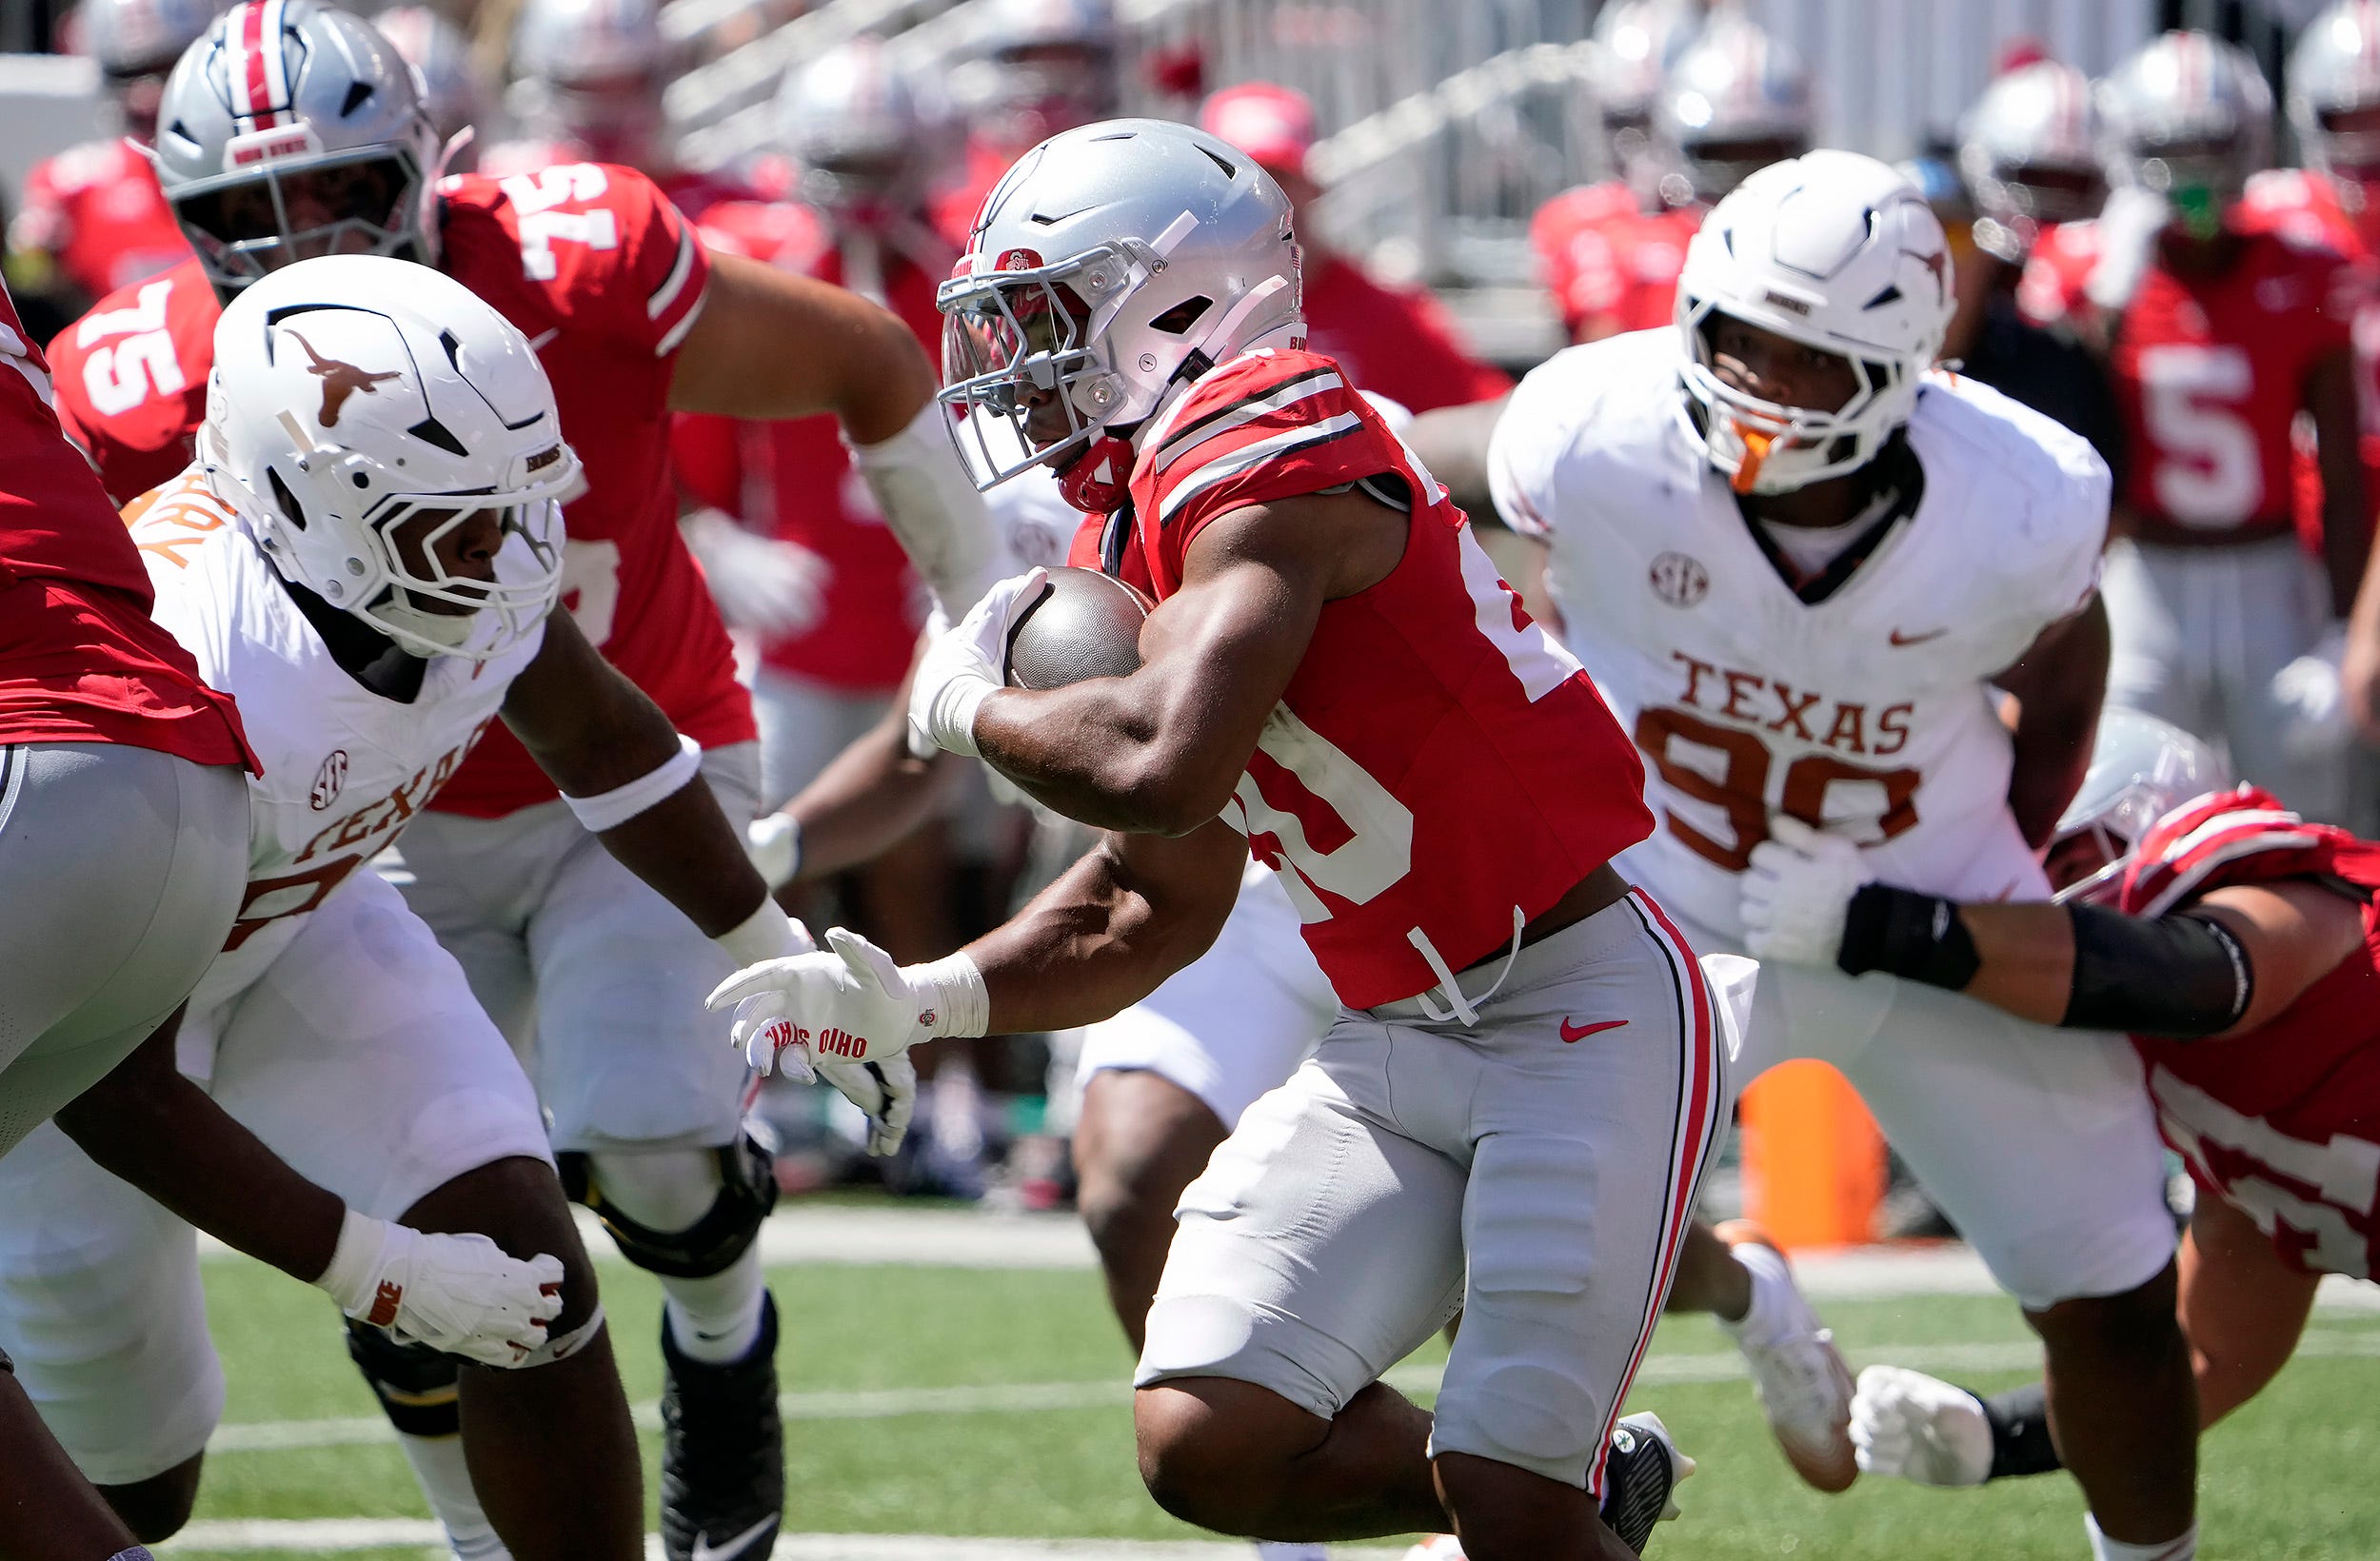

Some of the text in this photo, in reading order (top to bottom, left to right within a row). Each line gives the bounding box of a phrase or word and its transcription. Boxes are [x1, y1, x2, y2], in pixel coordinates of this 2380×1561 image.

[500, 162, 618, 282] 75
[76, 278, 186, 417] 75
[2138, 343, 2265, 530] 5
[1672, 649, 1914, 756] TEXAS
[309, 749, 348, 811] SEC
[1634, 704, 1921, 875] 90
[818, 1027, 868, 1058] OHIO
